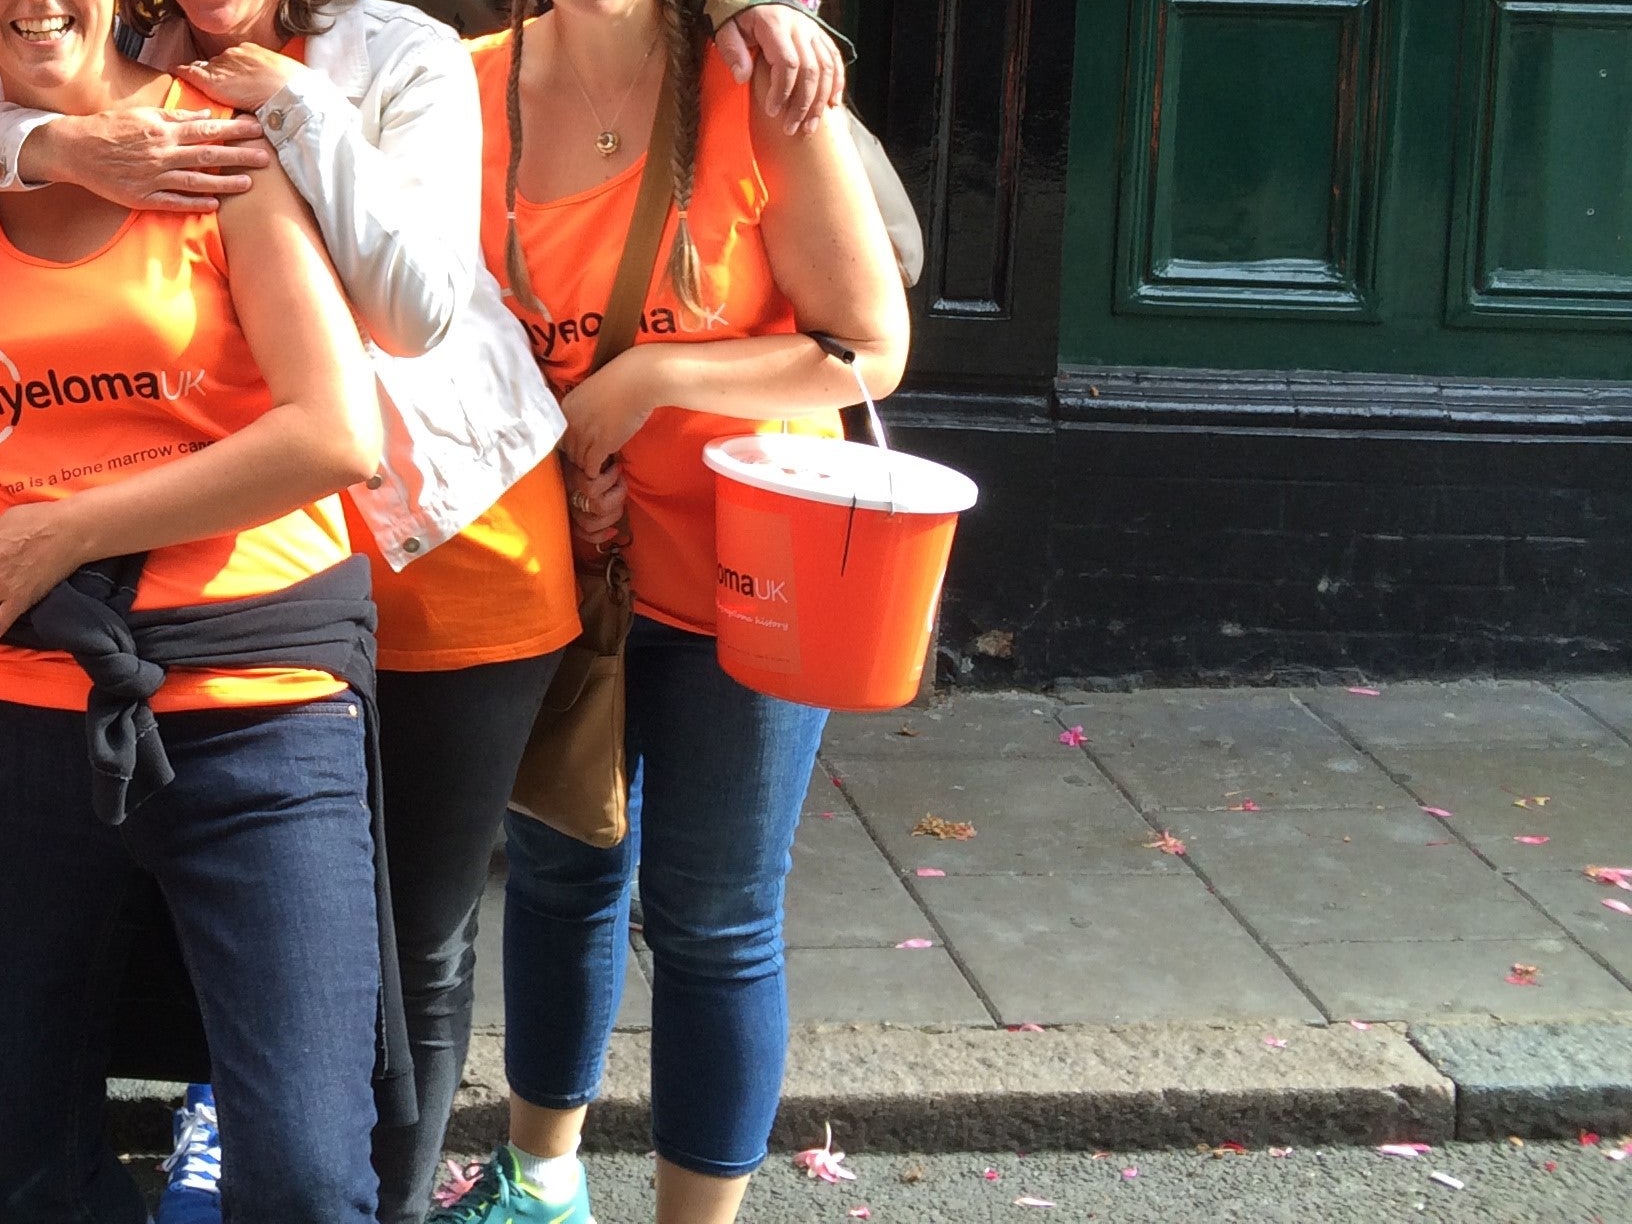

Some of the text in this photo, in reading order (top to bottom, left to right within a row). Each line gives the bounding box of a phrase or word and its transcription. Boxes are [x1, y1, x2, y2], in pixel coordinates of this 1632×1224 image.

[29, 475, 44, 488] is
[48, 475, 58, 486] a
[61, 462, 104, 482] bone
[107, 444, 173, 470] marrow
